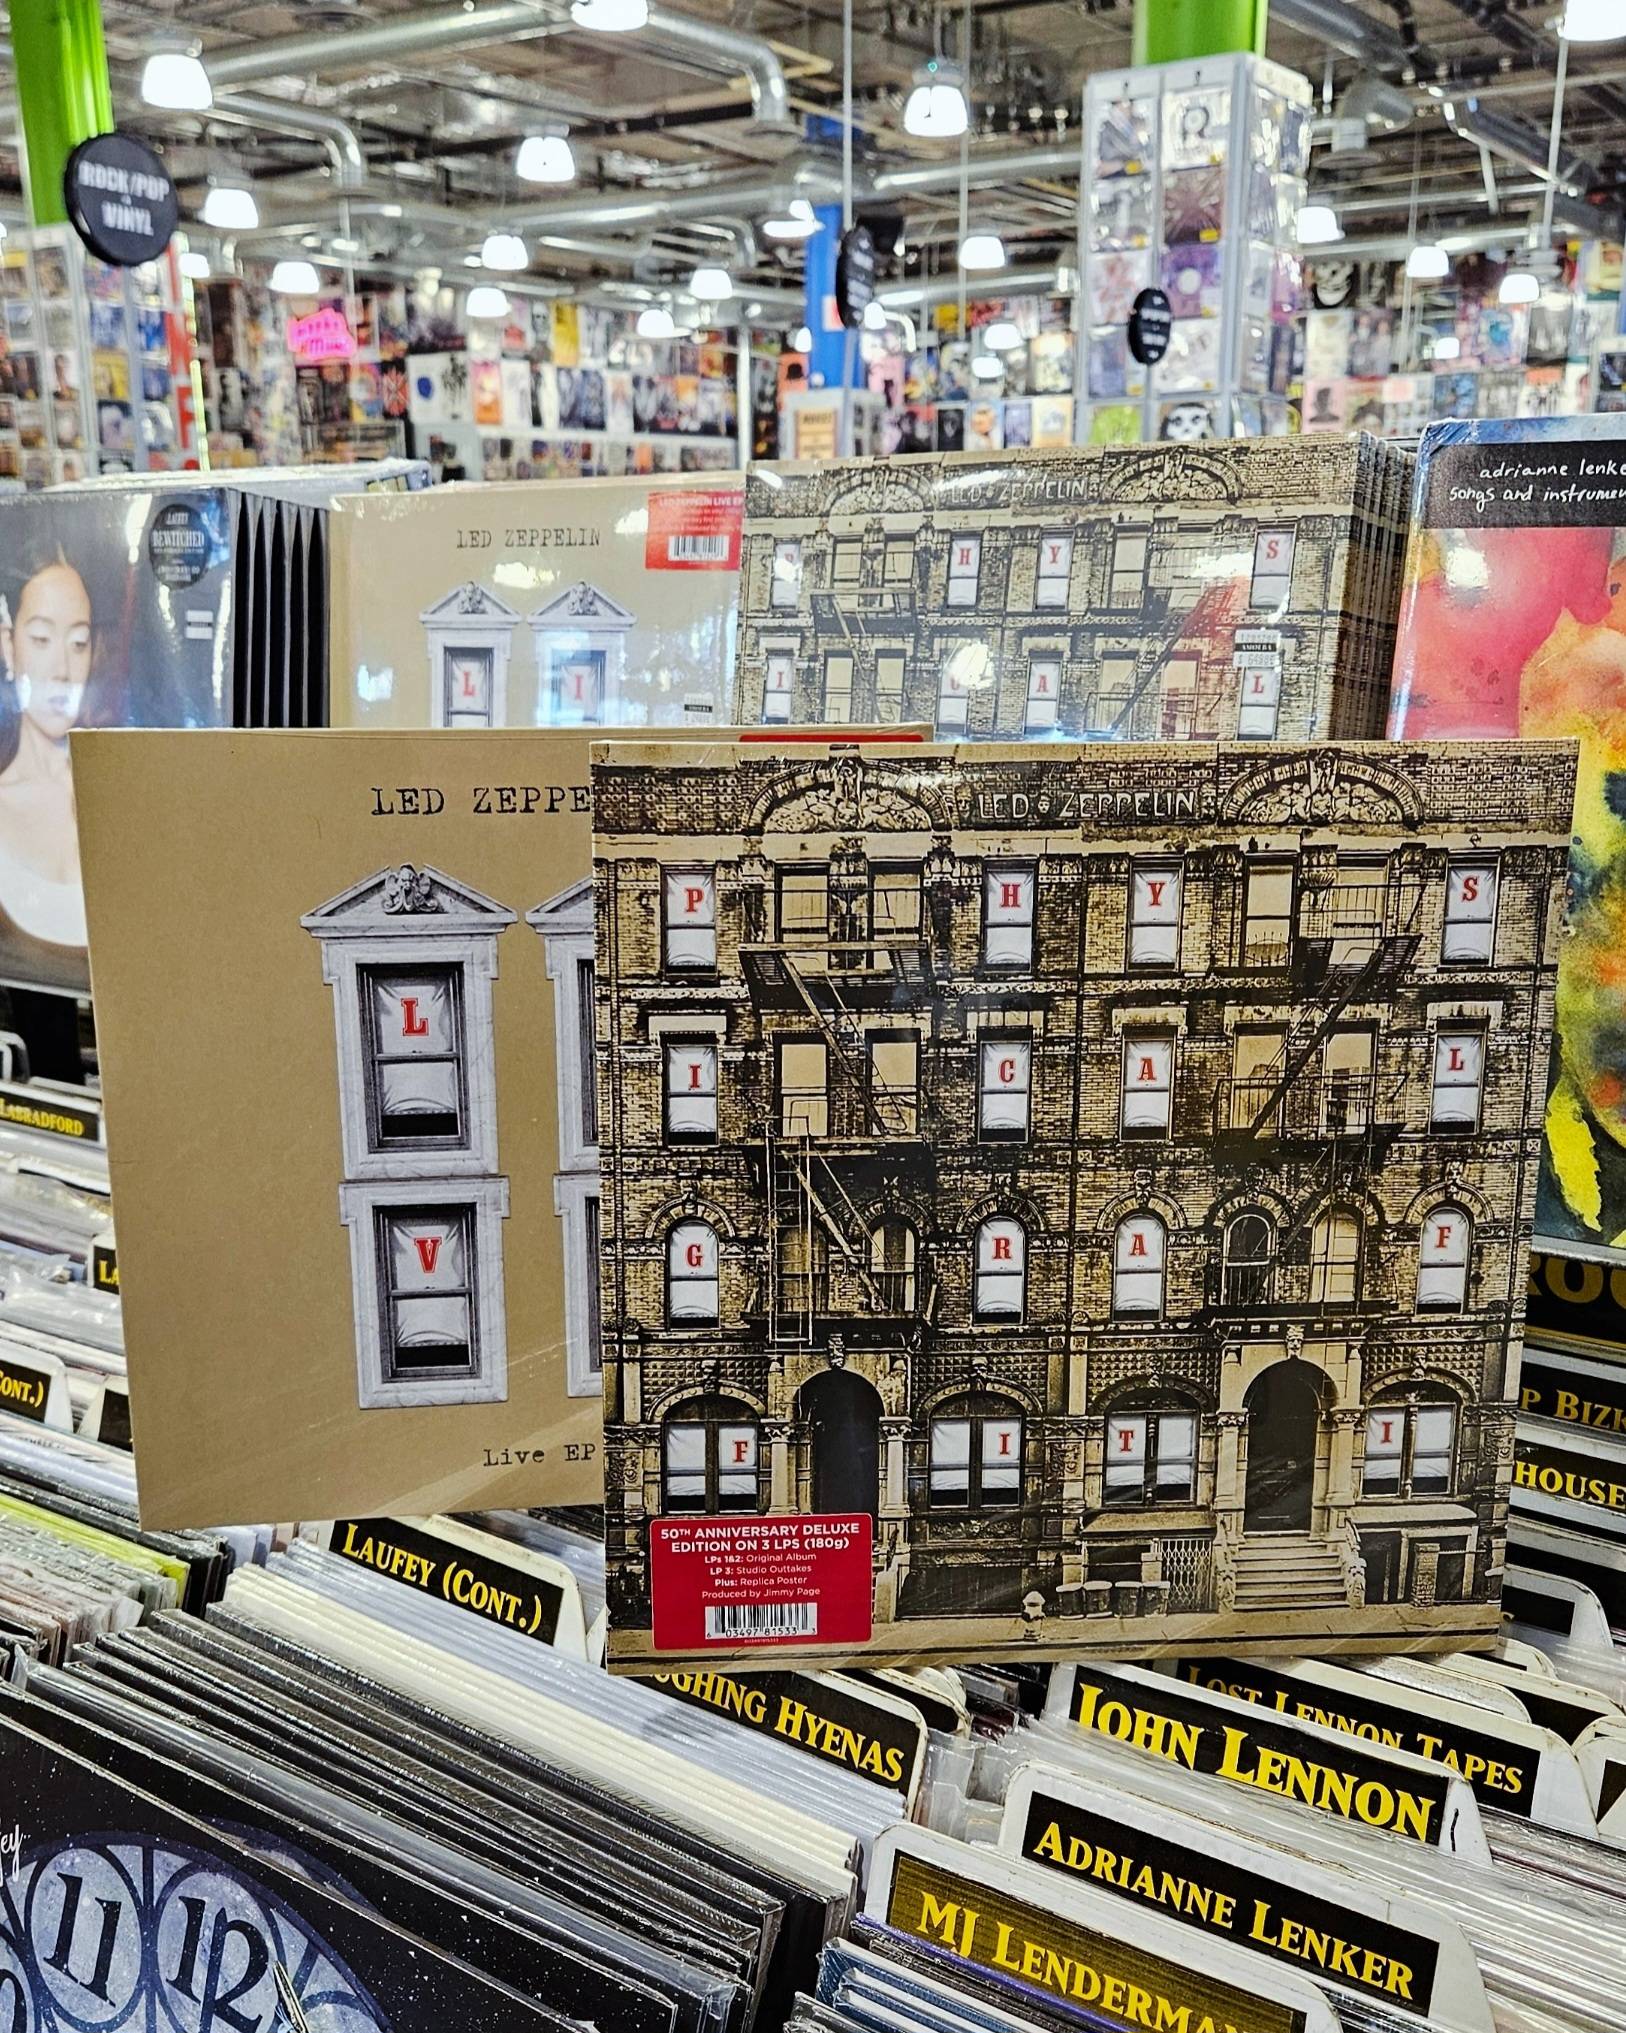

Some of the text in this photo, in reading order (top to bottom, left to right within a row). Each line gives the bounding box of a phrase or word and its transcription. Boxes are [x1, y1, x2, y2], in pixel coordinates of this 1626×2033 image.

[78, 160, 169, 202] ROCK/POP
[101, 201, 154, 236] VINYL
[1480, 462, 1568, 478] adrianne
[1000, 478, 1087, 500] ZEPPELIN
[1450, 486, 1495, 513] songs
[1503, 484, 1533, 501] and
[457, 527, 601, 549] LED ZEPPELIN
[958, 539, 1279, 565] H Y S
[462, 670, 584, 701] L I
[775, 671, 784, 689] I
[1251, 675, 1264, 694] L
[371, 787, 445, 815] LED
[978, 789, 1197, 819] LED ZEPPELIN
[684, 876, 1479, 914] P H Y S
[400, 996, 429, 1037] L
[689, 1046, 1463, 1089] I C A L
[413, 1236, 443, 1275] V
[684, 1224, 1452, 1269] G R A F
[483, 1443, 596, 1467] Live EP
[734, 1421, 1392, 1464] F I T I
[661, 1523, 860, 1539] 50TH ANNIVERSARY DELUXE
[671, 1537, 850, 1552] EDITION ON 3 LPS (180g)
[705, 1552, 817, 1564] LPs 1&2: Original Album
[710, 1564, 812, 1575] LP 3: Studio Outtakes
[342, 1523, 542, 1634] LAUFEY (CONT.)
[702, 1587, 821, 1599] Produced by Jimmy Page
[715, 1576, 808, 1587] Plus: Replica Poster
[725, 1628, 758, 1638] 03497
[764, 1626, 798, 1636] 81533
[774, 1696, 904, 1782] HYENAS
[1079, 1682, 1436, 1842] JOHN LENNON
[1417, 1733, 1522, 1794] TAPES
[917, 1891, 981, 1958] MJ
[1033, 1822, 1413, 1999] ADRIANNE LENKER
